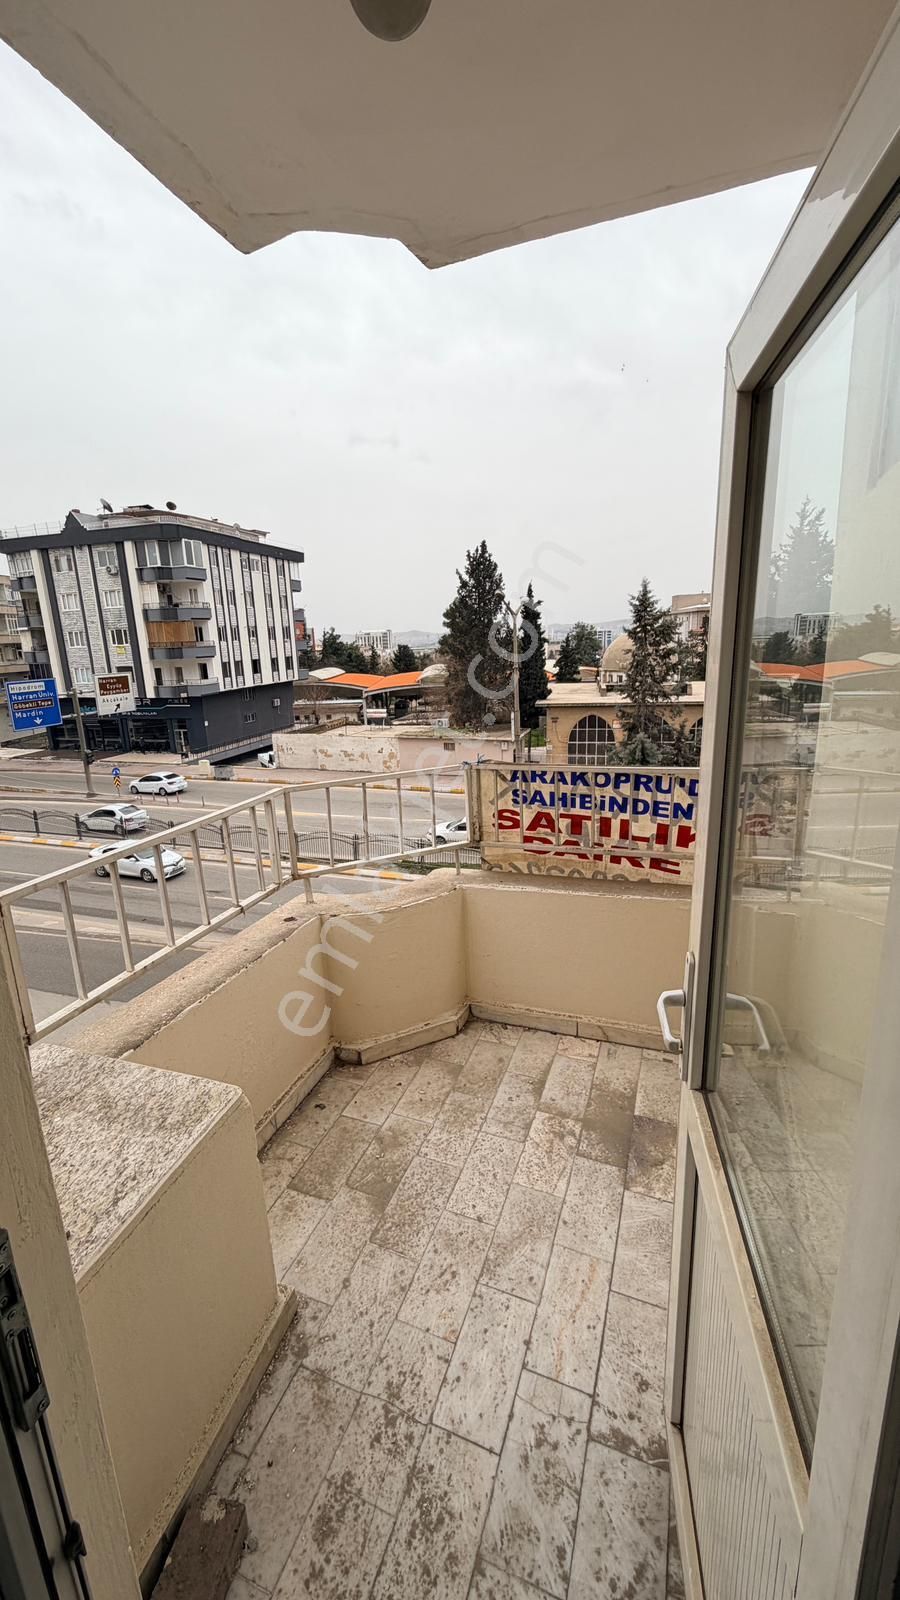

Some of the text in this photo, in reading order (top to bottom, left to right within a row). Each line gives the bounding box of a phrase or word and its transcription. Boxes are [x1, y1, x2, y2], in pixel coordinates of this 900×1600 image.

[10, 684, 44, 692] Hipodrom
[12, 693, 38, 701] Harran
[15, 710, 44, 718] Mardin
